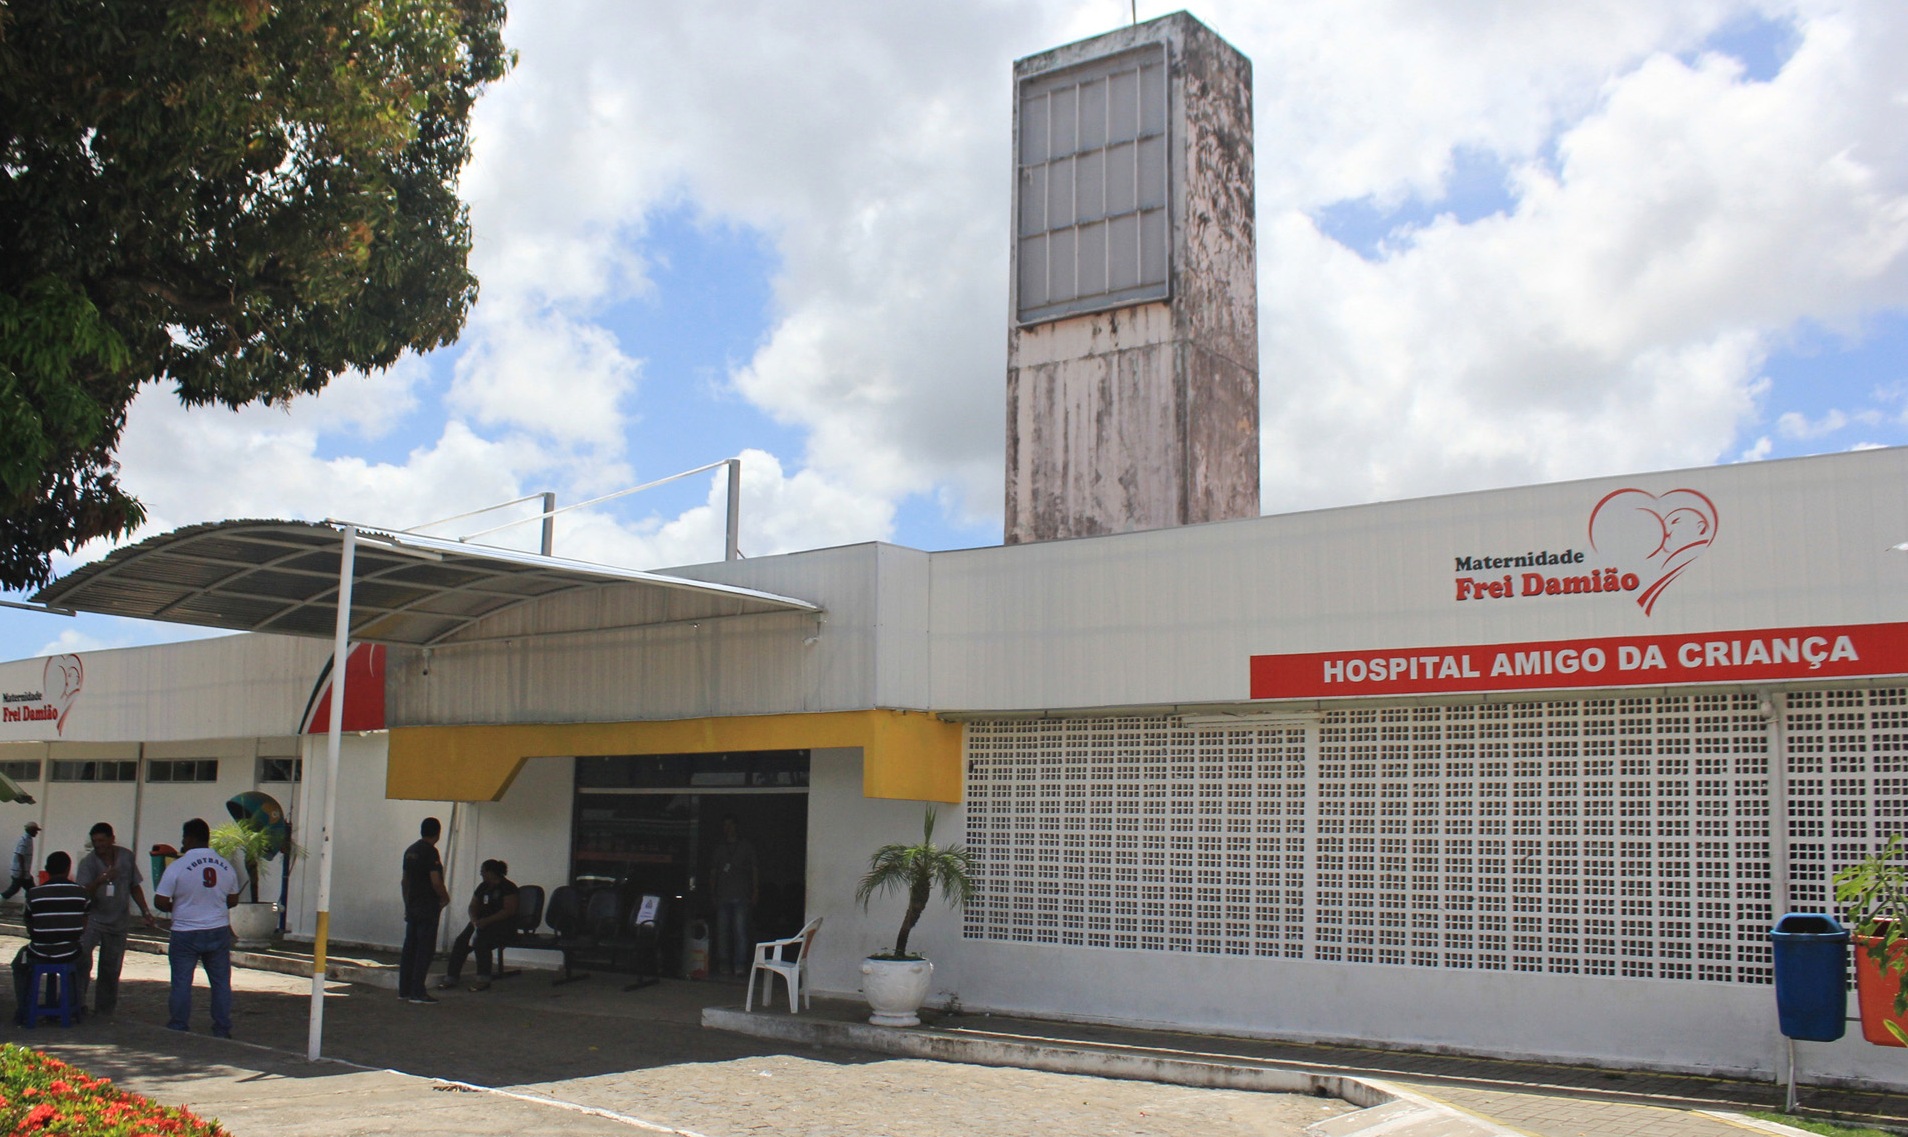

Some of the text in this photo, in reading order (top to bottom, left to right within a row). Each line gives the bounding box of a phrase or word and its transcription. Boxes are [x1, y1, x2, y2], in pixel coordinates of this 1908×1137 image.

[1455, 549, 1584, 572] Maternidade
[1455, 567, 1640, 600] Frei Damião
[1323, 635, 1859, 683] HOSPITAL AMIGO DA CRIANÇA
[3, 704, 58, 722] Frei Damião
[187, 858, 228, 871] FOOTBALL
[203, 867, 217, 888] 9
